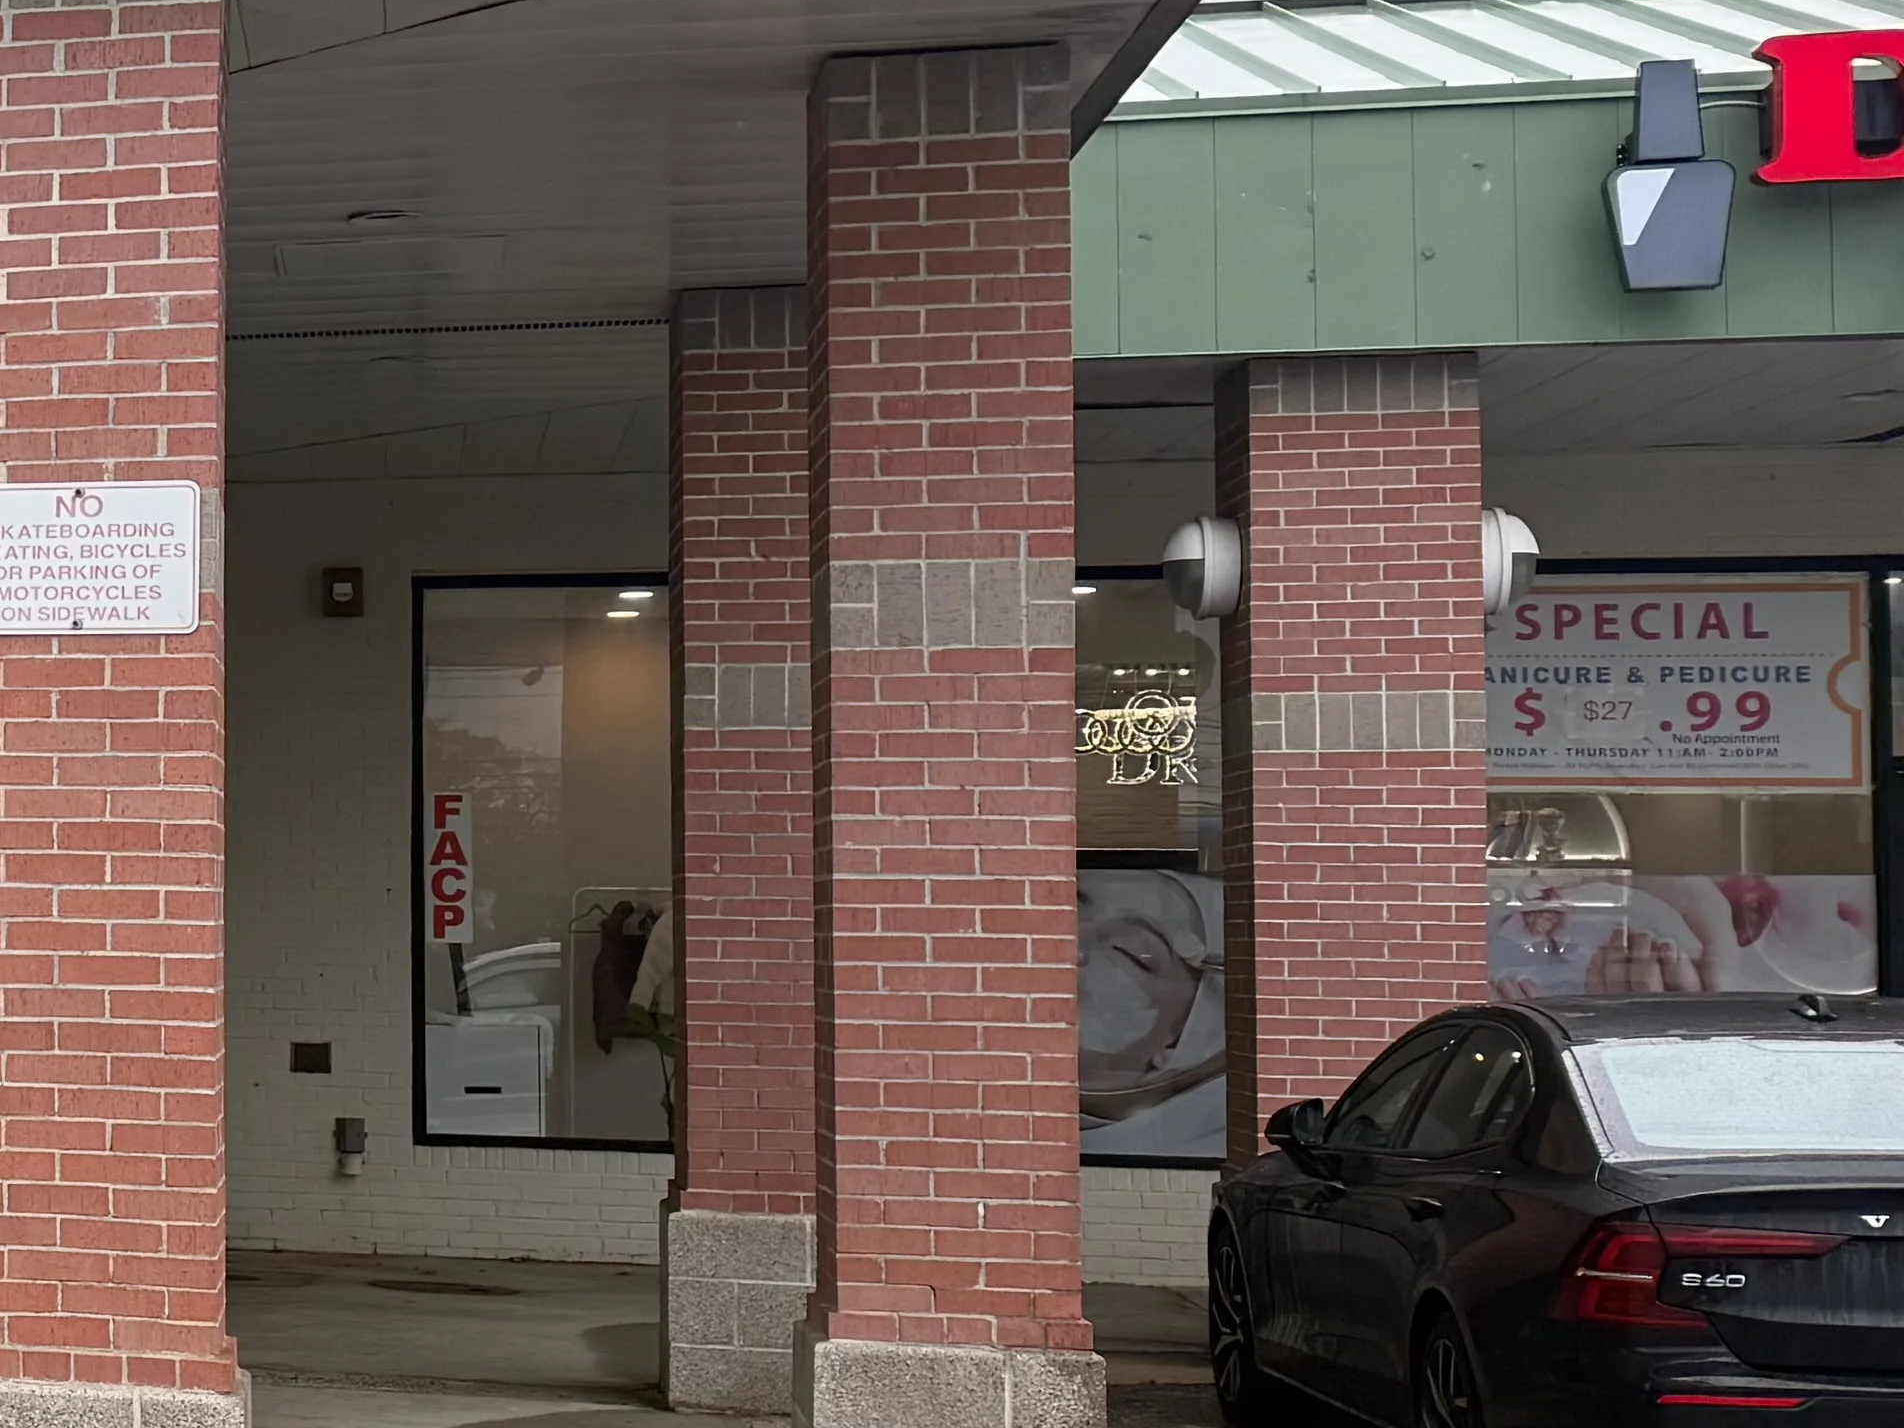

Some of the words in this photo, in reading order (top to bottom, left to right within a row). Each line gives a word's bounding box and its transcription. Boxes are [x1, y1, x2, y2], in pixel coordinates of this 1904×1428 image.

[55, 495, 104, 518] NO
[79, 543, 187, 559] BICYCLES
[29, 565, 127, 580] PARKING
[132, 563, 162, 579] OF
[0, 607, 32, 622] ON
[37, 605, 151, 622] SIDEWALK
[1514, 602, 1770, 641] SPECIAL
[1485, 665, 1612, 685] ANICURE
[1626, 665, 1646, 684] &
[1660, 664, 1812, 684] PEDICURE
[1582, 700, 1633, 721] $27
[1672, 733, 1691, 745] No
[1694, 733, 1781, 747] Appointment
[1565, 746, 1650, 758] THURSDAY
[1681, 1272, 1747, 1289] S60
